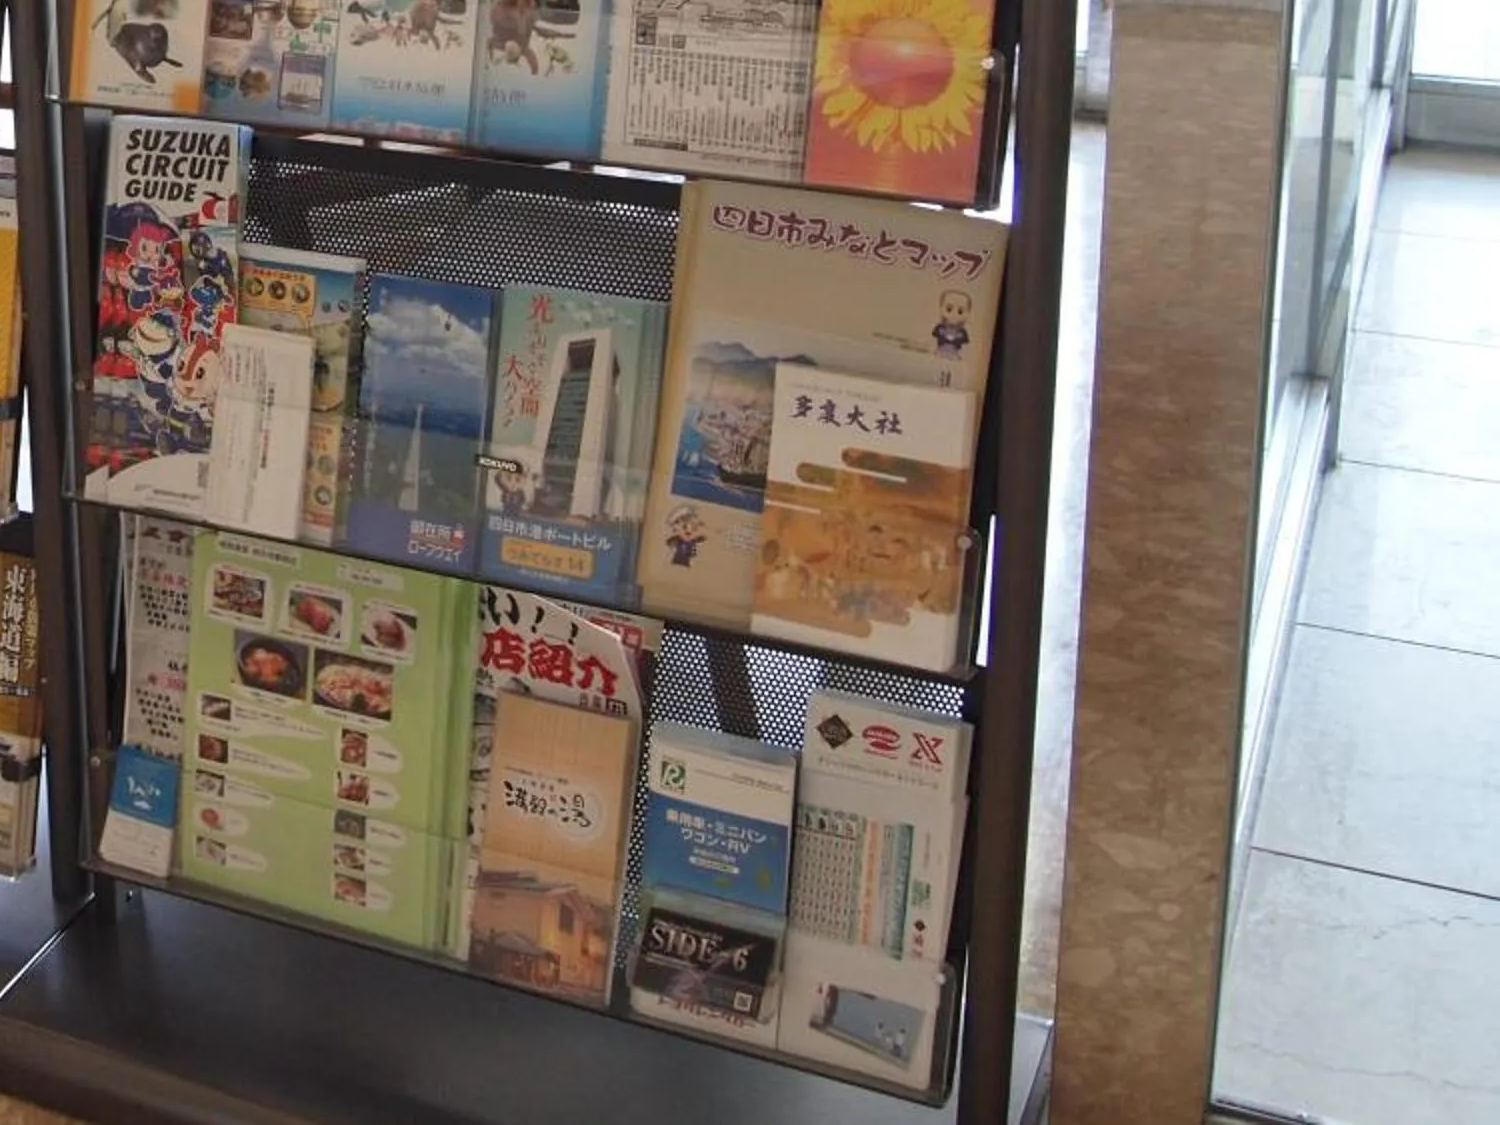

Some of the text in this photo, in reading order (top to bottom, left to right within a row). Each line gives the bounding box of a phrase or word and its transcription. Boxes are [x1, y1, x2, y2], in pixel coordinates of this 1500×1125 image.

[125, 127, 232, 159] SUZUKA
[125, 153, 230, 185] CIRCUIT
[125, 178, 198, 204] GUIDE
[712, 202, 992, 280] 四日市みなとマップ
[789, 393, 904, 436] 多度大社
